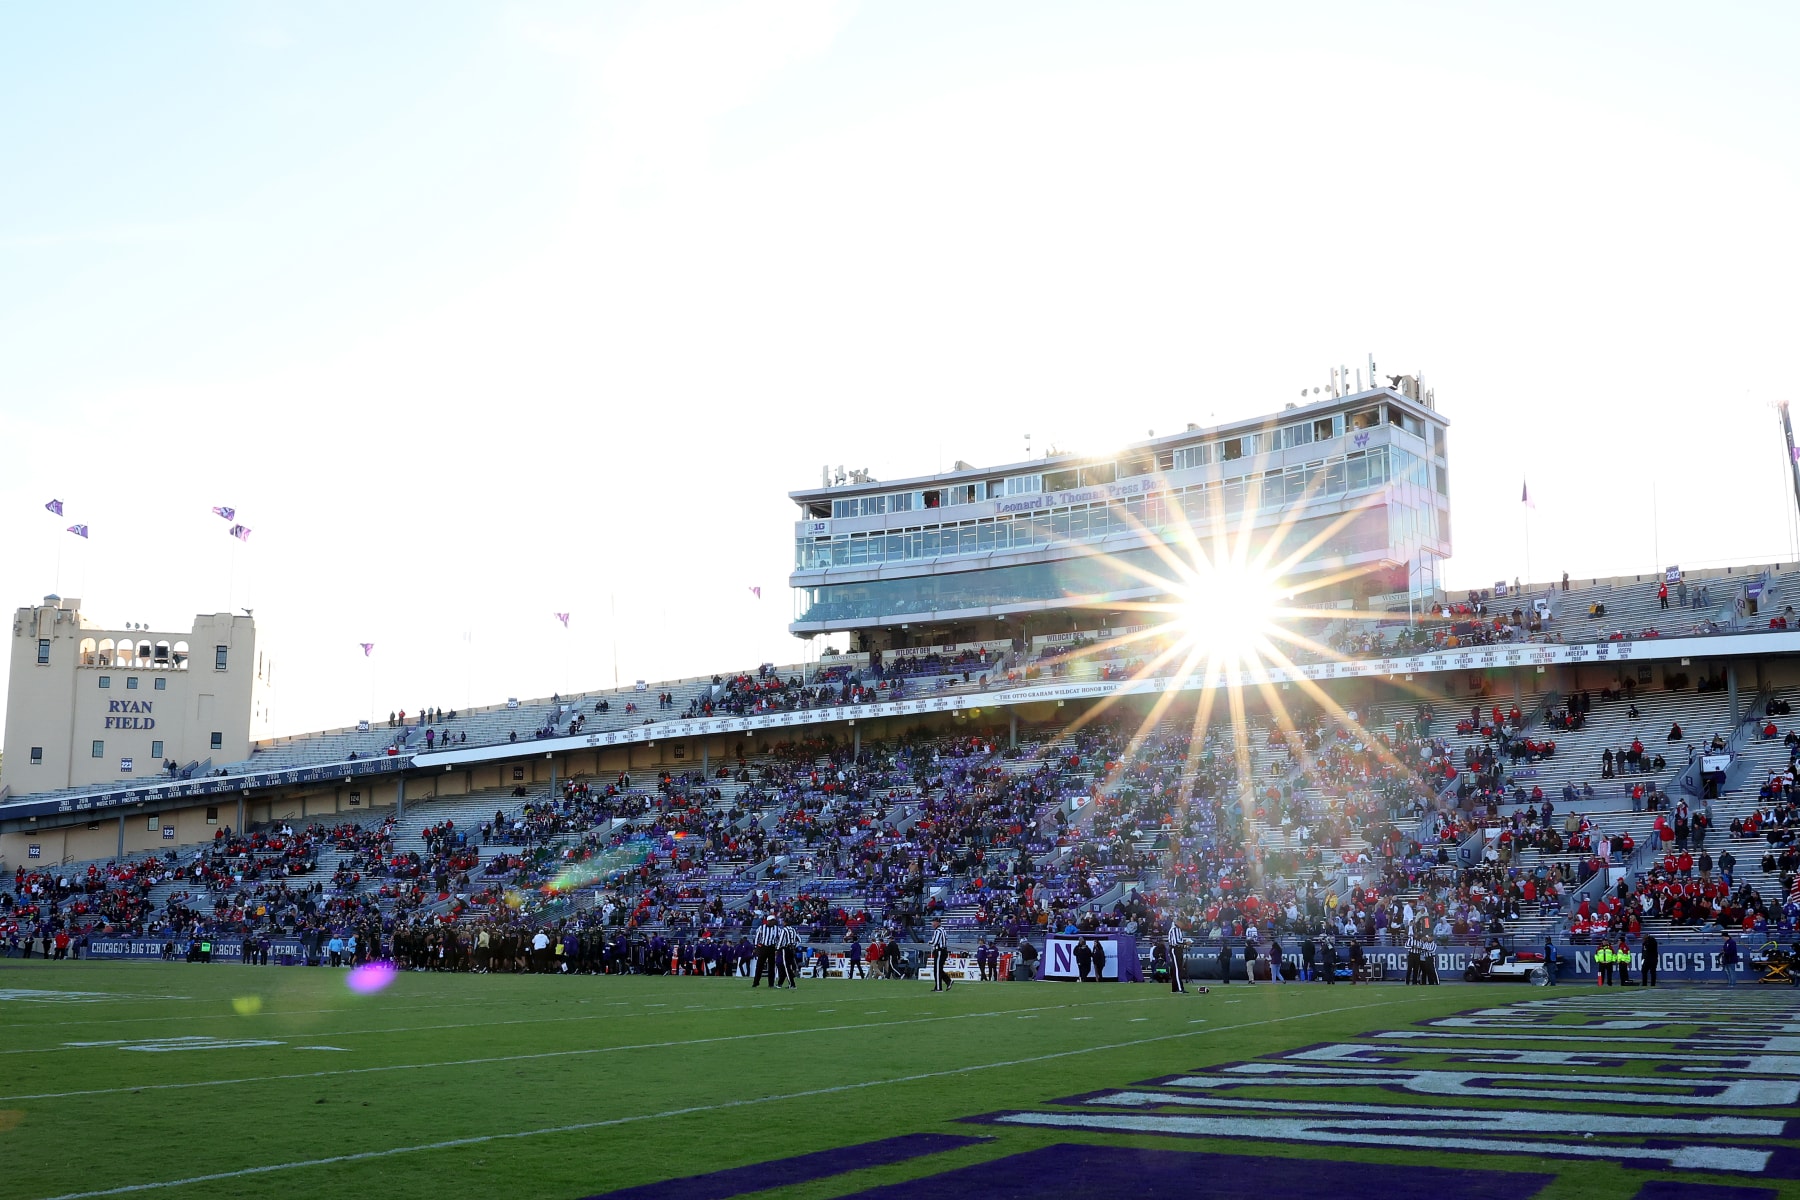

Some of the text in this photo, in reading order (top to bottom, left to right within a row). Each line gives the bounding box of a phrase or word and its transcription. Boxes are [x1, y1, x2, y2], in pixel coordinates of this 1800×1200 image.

[996, 479, 1164, 514] Leonard B. Thomas Press Box
[1667, 571, 1680, 580] 232
[1496, 586, 1506, 594] 231
[1046, 634, 1072, 642] WILDCAT
[895, 648, 920, 656] WILDCAT
[108, 700, 152, 714] RYAN
[104, 716, 155, 730] FIELD
[359, 766, 375, 774] CITRUS
[240, 781, 260, 789] OUTBACK
[144, 793, 163, 801] OUTBACK
[92, 942, 184, 954] CHICAGO'S BIG TEN TAM
[211, 944, 241, 956] ICAGO'S
[1054, 943, 1072, 972] N
[1438, 953, 1466, 970] BIG
[1575, 951, 1591, 973] N
[1710, 952, 1744, 972] BG
[839, 959, 845, 968] N
[959, 959, 966, 969] N
